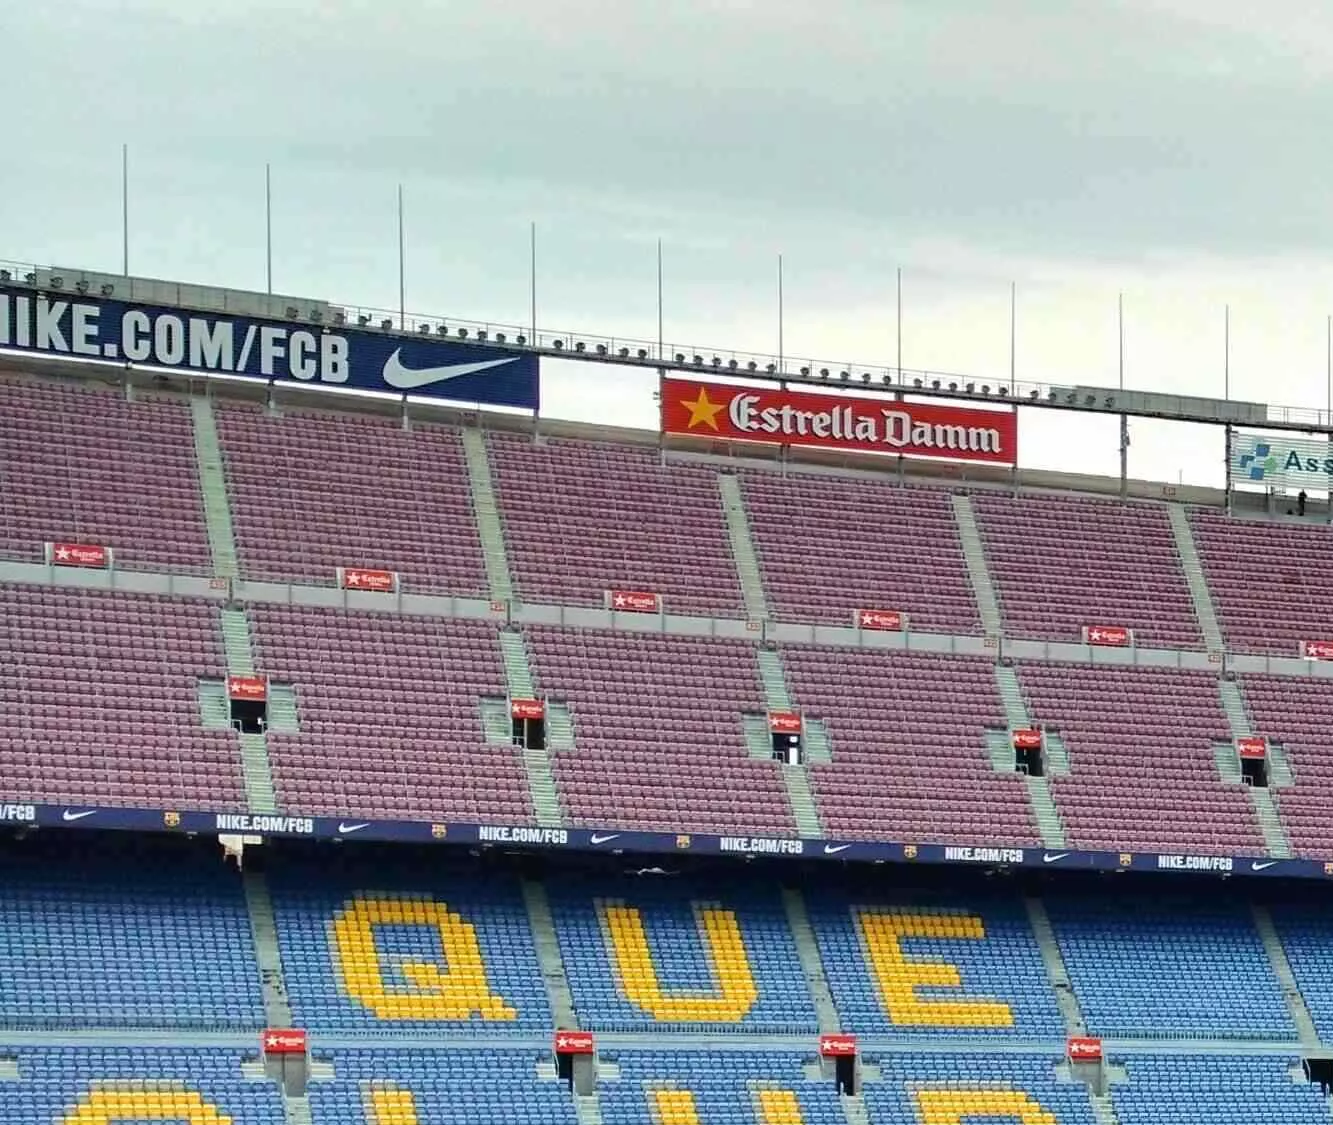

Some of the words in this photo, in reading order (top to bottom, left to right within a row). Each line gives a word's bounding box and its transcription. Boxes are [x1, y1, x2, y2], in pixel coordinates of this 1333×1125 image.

[729, 391, 876, 441] Estrella
[881, 408, 1002, 453] Damm
[216, 814, 314, 834] NIKE.COM/FCB
[478, 826, 568, 845] NIKE.COM/FCB
[720, 837, 803, 854] NIKE.COM/FCB
[944, 847, 1024, 863] NIKE.COM/FCB
[1158, 855, 1233, 870] NIKE.COM/FCB
[331, 892, 1015, 1028] QUE
